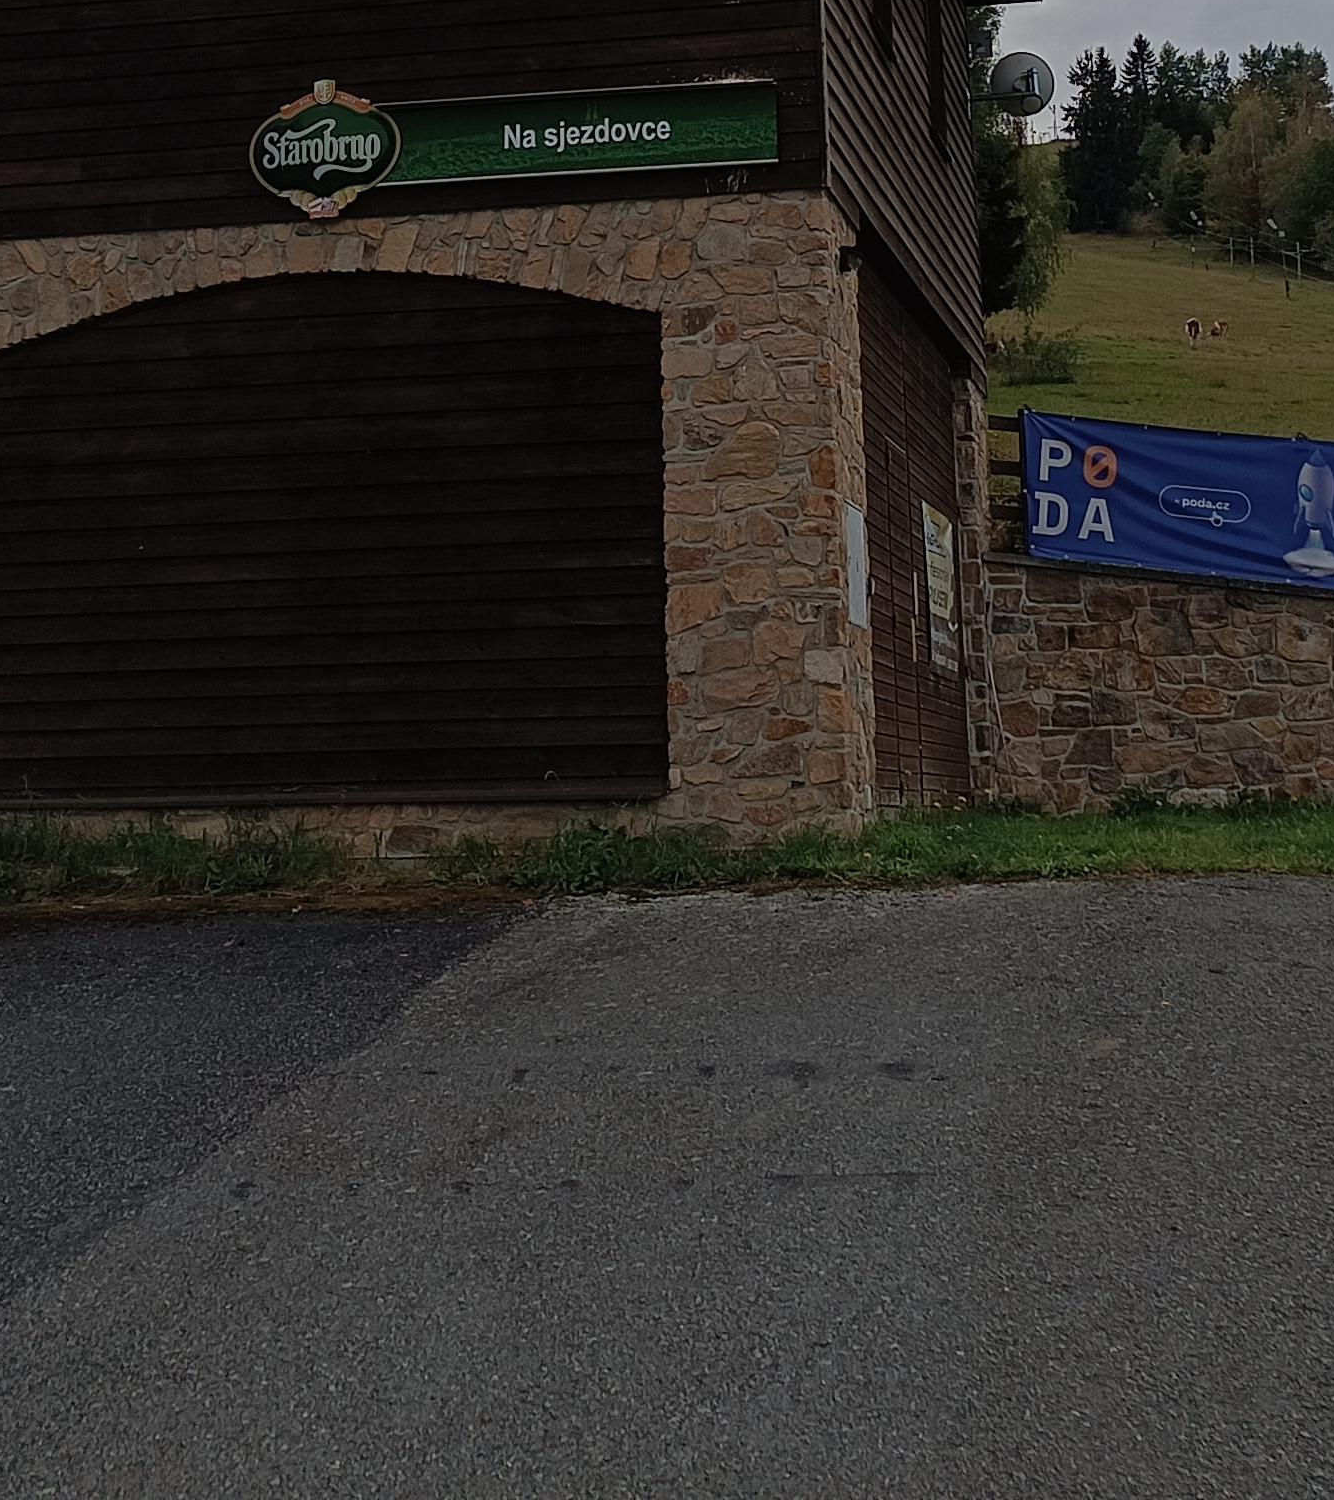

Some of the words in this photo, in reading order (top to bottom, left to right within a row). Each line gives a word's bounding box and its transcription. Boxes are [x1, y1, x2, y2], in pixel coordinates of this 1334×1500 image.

[262, 118, 382, 181] Starobrno
[503, 123, 537, 149] Na
[543, 117, 672, 152] sjezdovce
[1181, 497, 1231, 511] poda.cz
